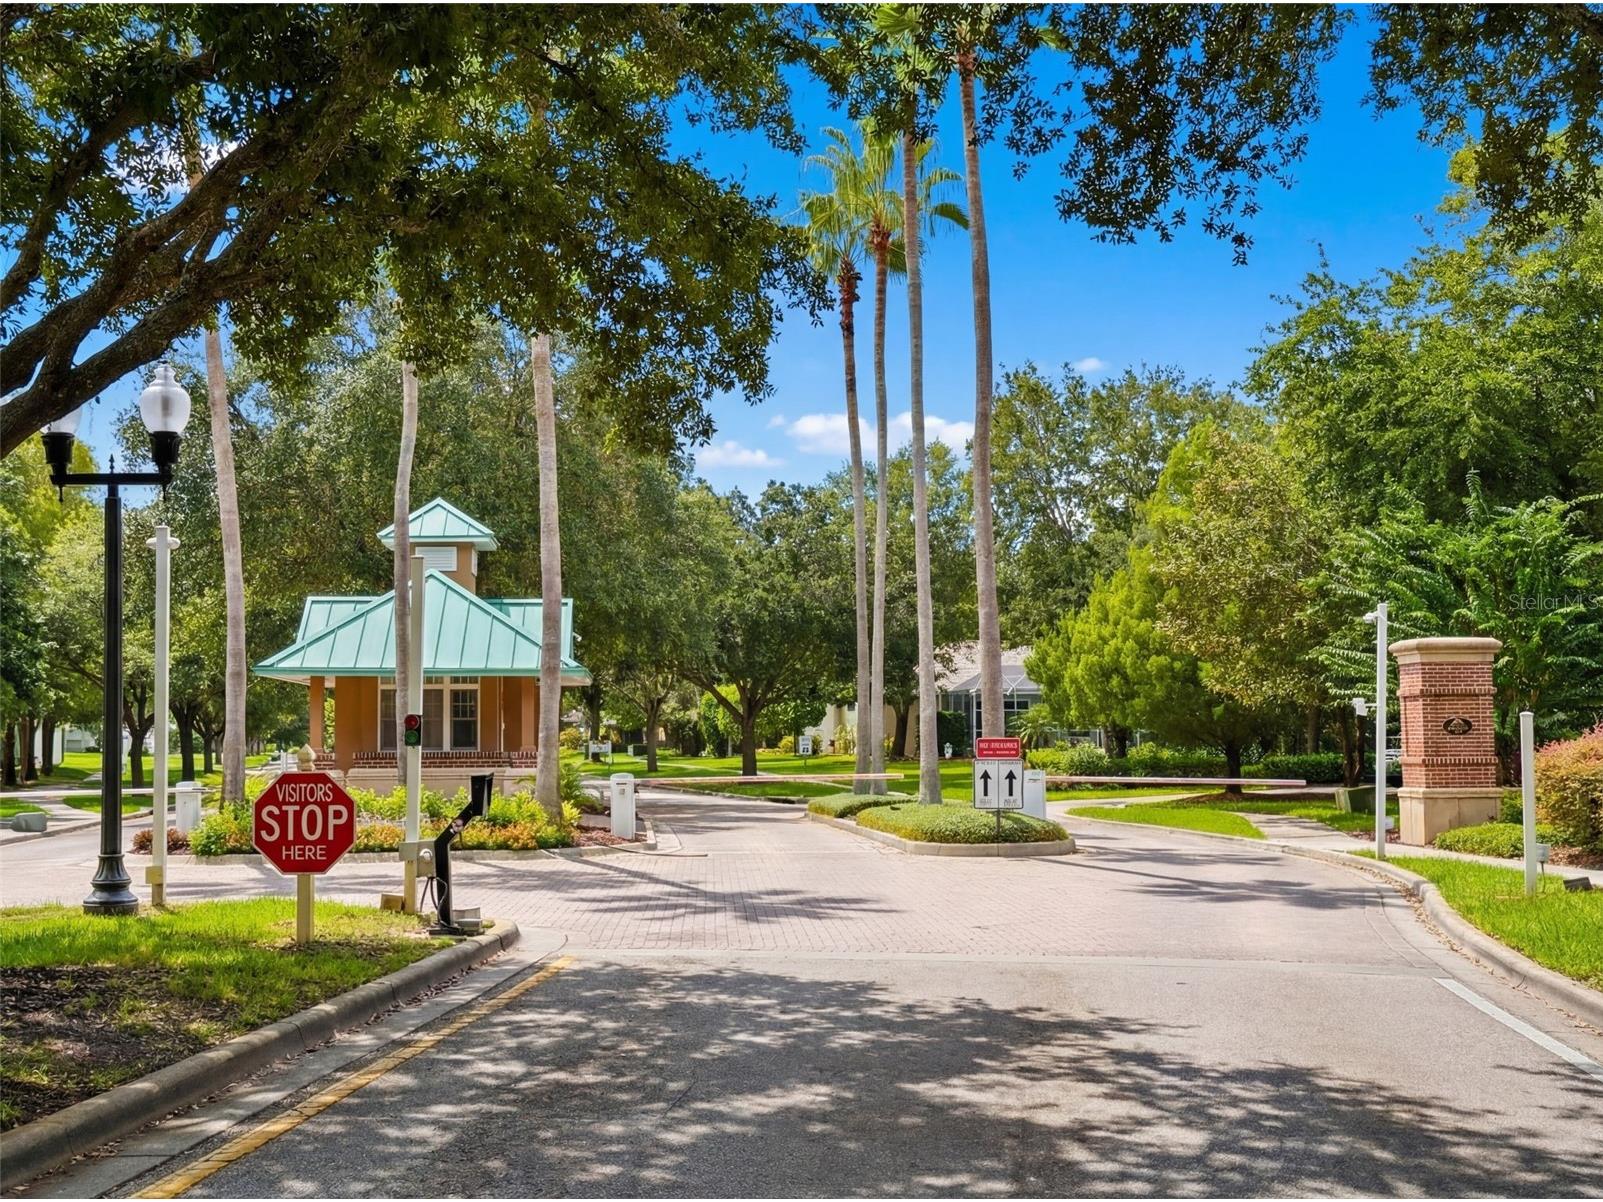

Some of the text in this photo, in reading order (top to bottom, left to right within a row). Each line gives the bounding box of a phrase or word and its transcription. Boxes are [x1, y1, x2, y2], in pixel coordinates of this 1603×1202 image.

[275, 783, 333, 802] VISITORS
[260, 804, 348, 842] STOP
[282, 845, 327, 860] HERE
